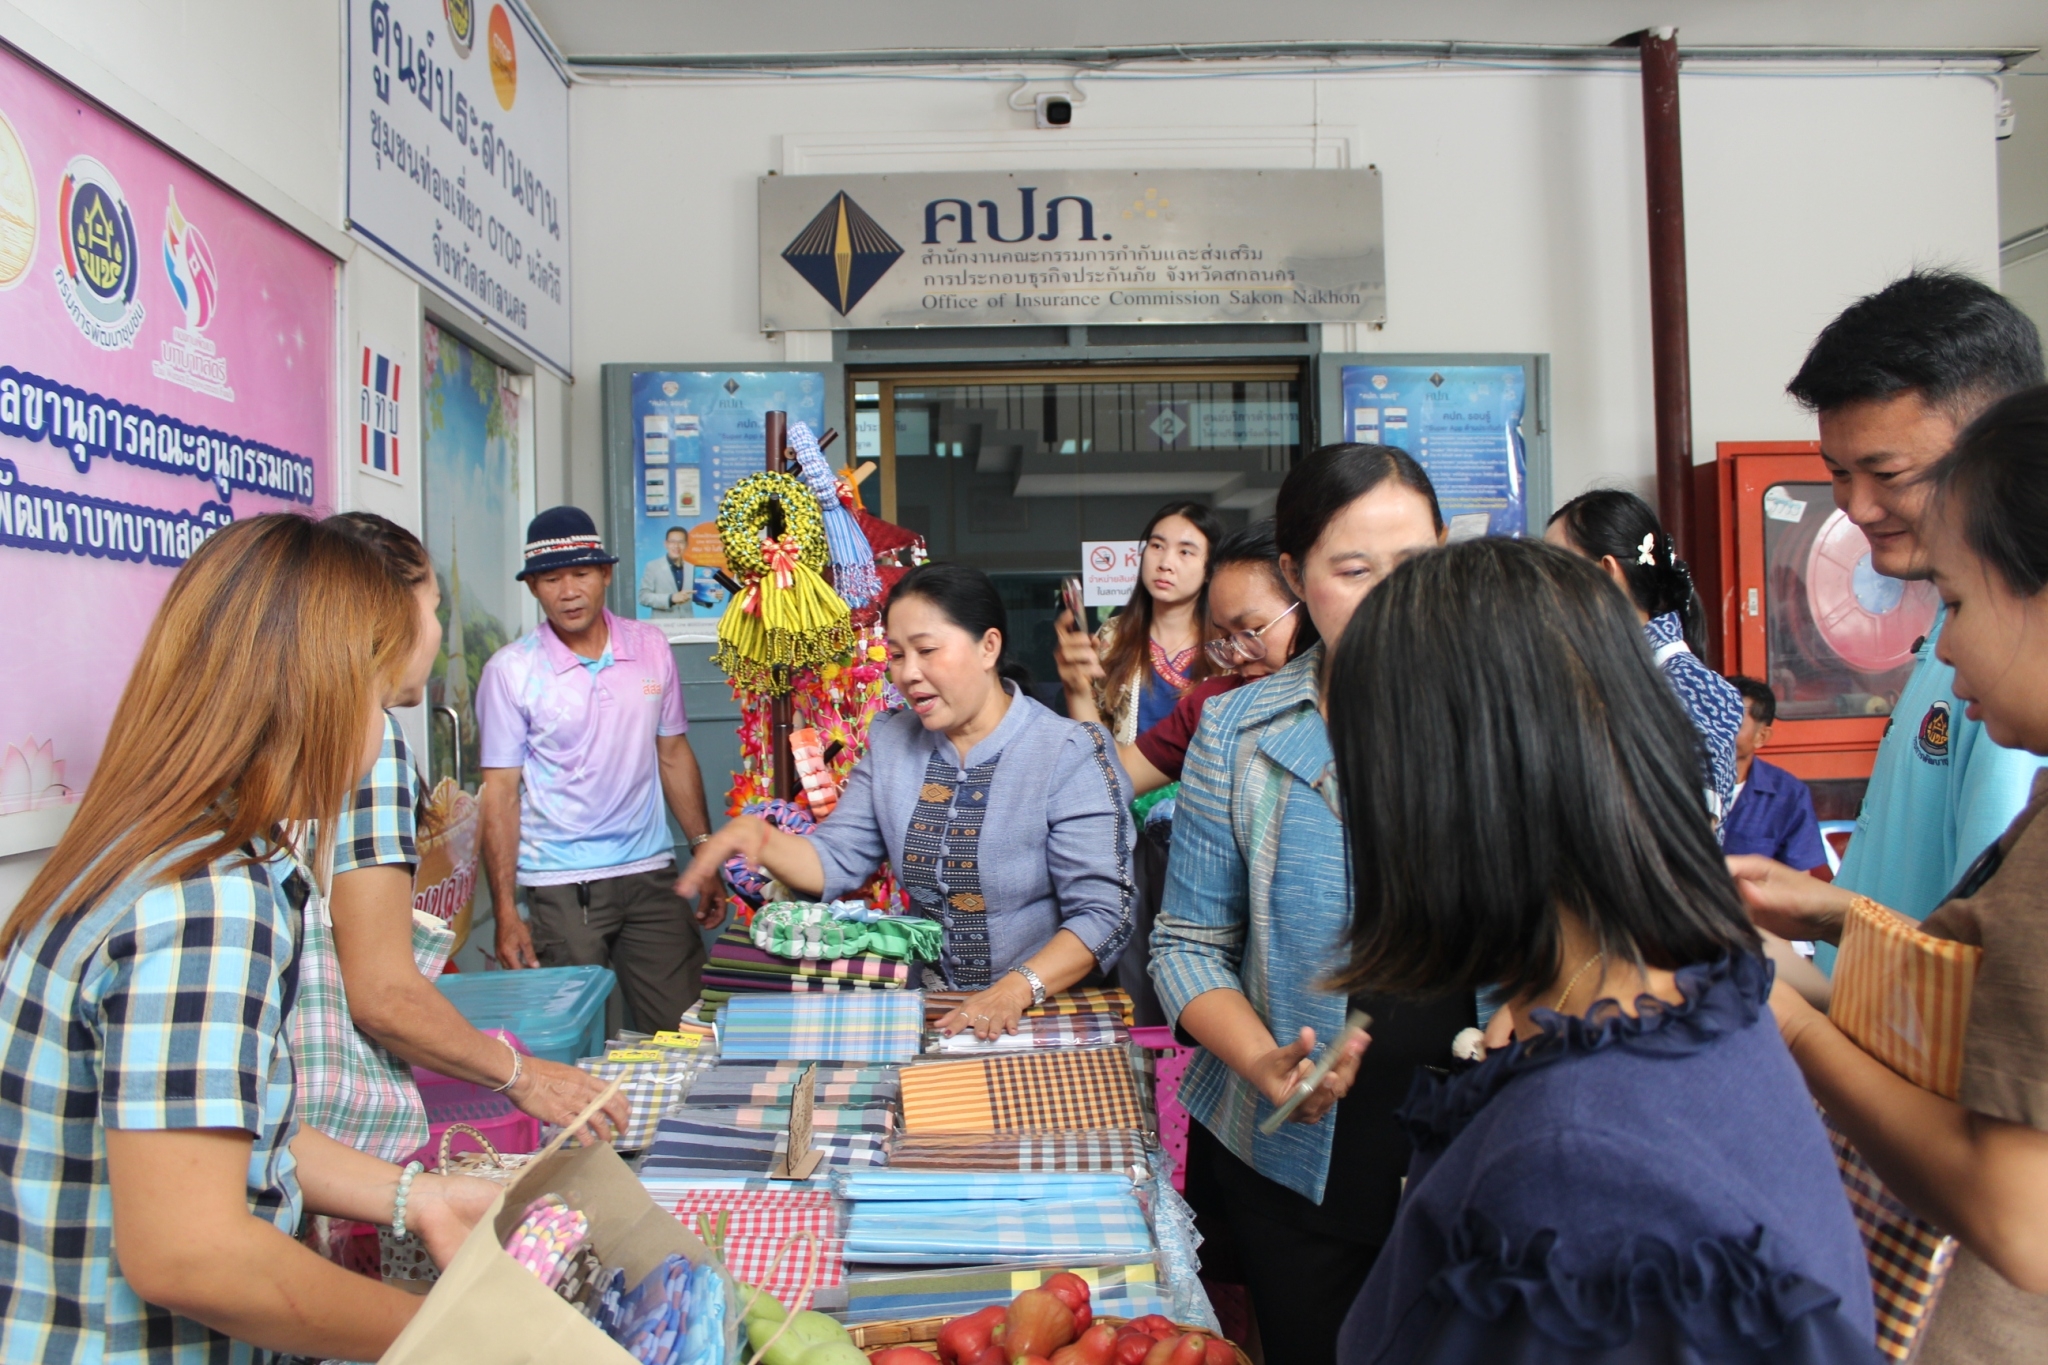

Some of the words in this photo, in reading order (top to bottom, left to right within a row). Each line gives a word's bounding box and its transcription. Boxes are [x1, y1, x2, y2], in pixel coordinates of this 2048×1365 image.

[370, 0, 560, 241] ศูนย์ประสานงาน
[370, 109, 483, 238] ชุมชนท่องเที่ยว
[488, 215, 522, 269] OTOP
[921, 187, 1112, 244] คปภ.
[432, 218, 527, 330] จังหวัดสกลนคร
[921, 243, 1263, 265] สำนักงานคณะกรรมการกำกับและส่งเสริม
[924, 265, 1156, 288] การประกอบธุรกิจประกันภัย
[1167, 265, 1296, 282] จังหวัดสกลนคร
[55, 267, 145, 348] กรมการพัฒนาชุมชน
[921, 294, 978, 309] Office
[987, 293, 1007, 308] of
[1015, 292, 1100, 307] Insurance
[1109, 290, 1220, 306] Commission
[1229, 290, 1283, 305] Sakon
[1292, 290, 1360, 305] Nakhon
[1162, 418, 1175, 434] 2
